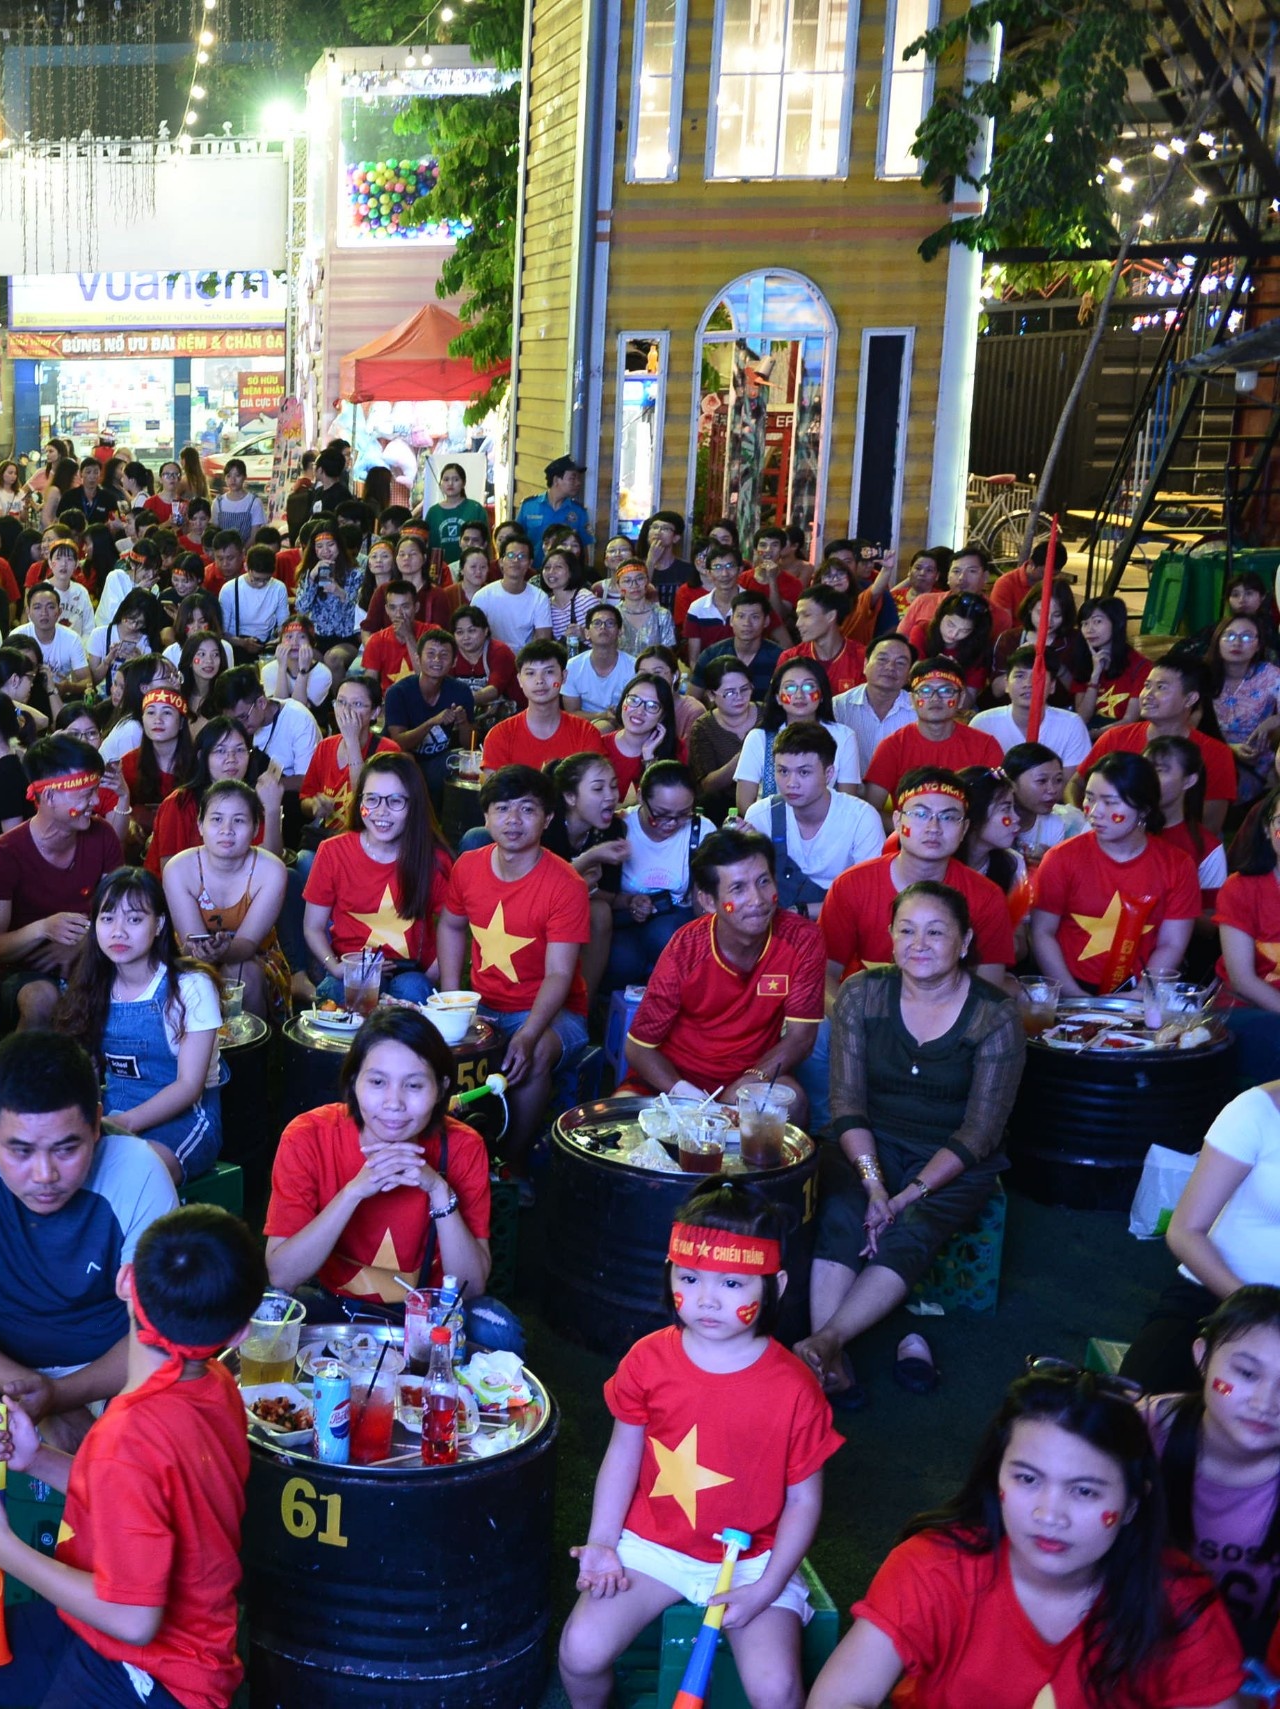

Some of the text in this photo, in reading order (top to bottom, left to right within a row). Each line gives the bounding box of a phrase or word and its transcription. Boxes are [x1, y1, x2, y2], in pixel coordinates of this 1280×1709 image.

[177, 333, 207, 352] NỆM
[211, 336, 222, 349] &
[225, 332, 262, 349] CHĂN
[265, 335, 284, 348] GA
[281, 1477, 348, 1547] 61
